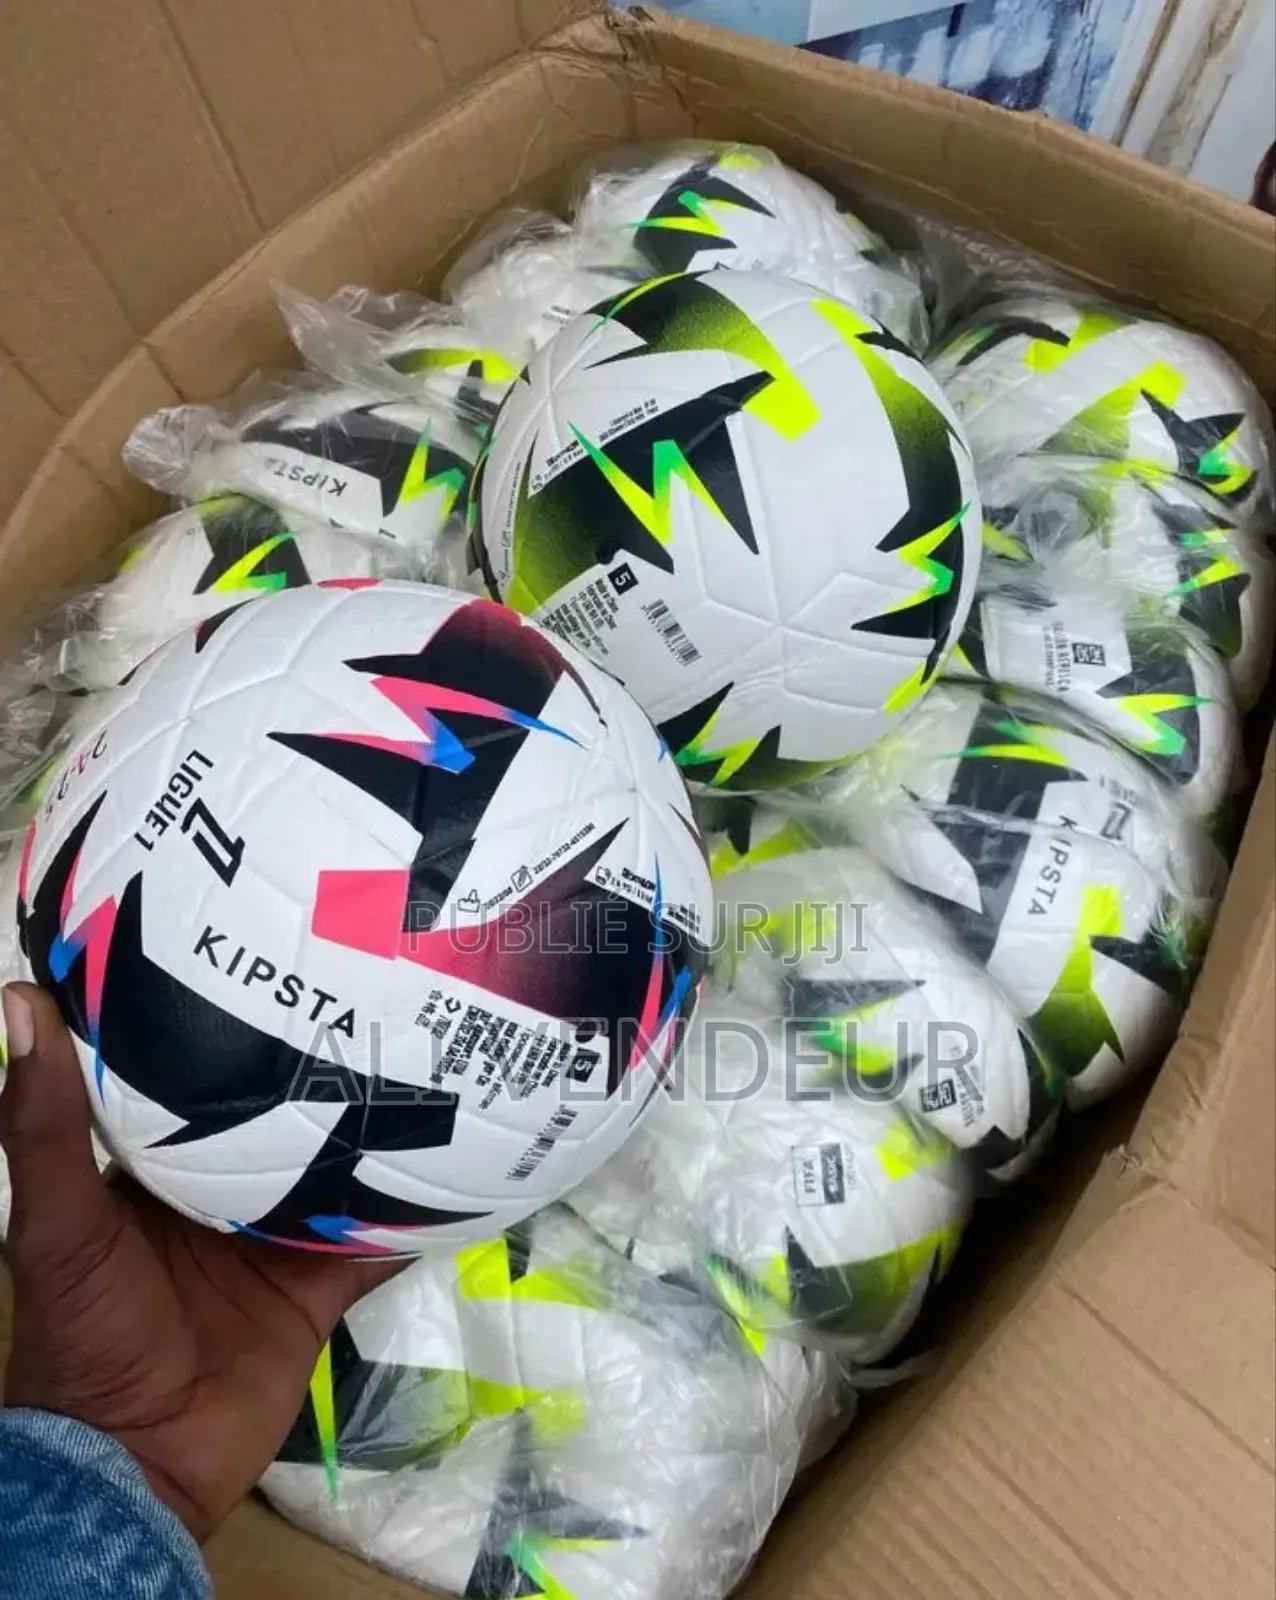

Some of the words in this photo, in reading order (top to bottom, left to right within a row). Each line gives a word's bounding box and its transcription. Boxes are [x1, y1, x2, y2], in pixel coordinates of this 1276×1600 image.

[144, 749, 214, 837] LIGUE
[134, 832, 155, 852] 1
[1027, 815, 1078, 915] KIPSTA
[193, 925, 356, 1038] KIPSTA
[804, 1160, 816, 1194] FIFA
